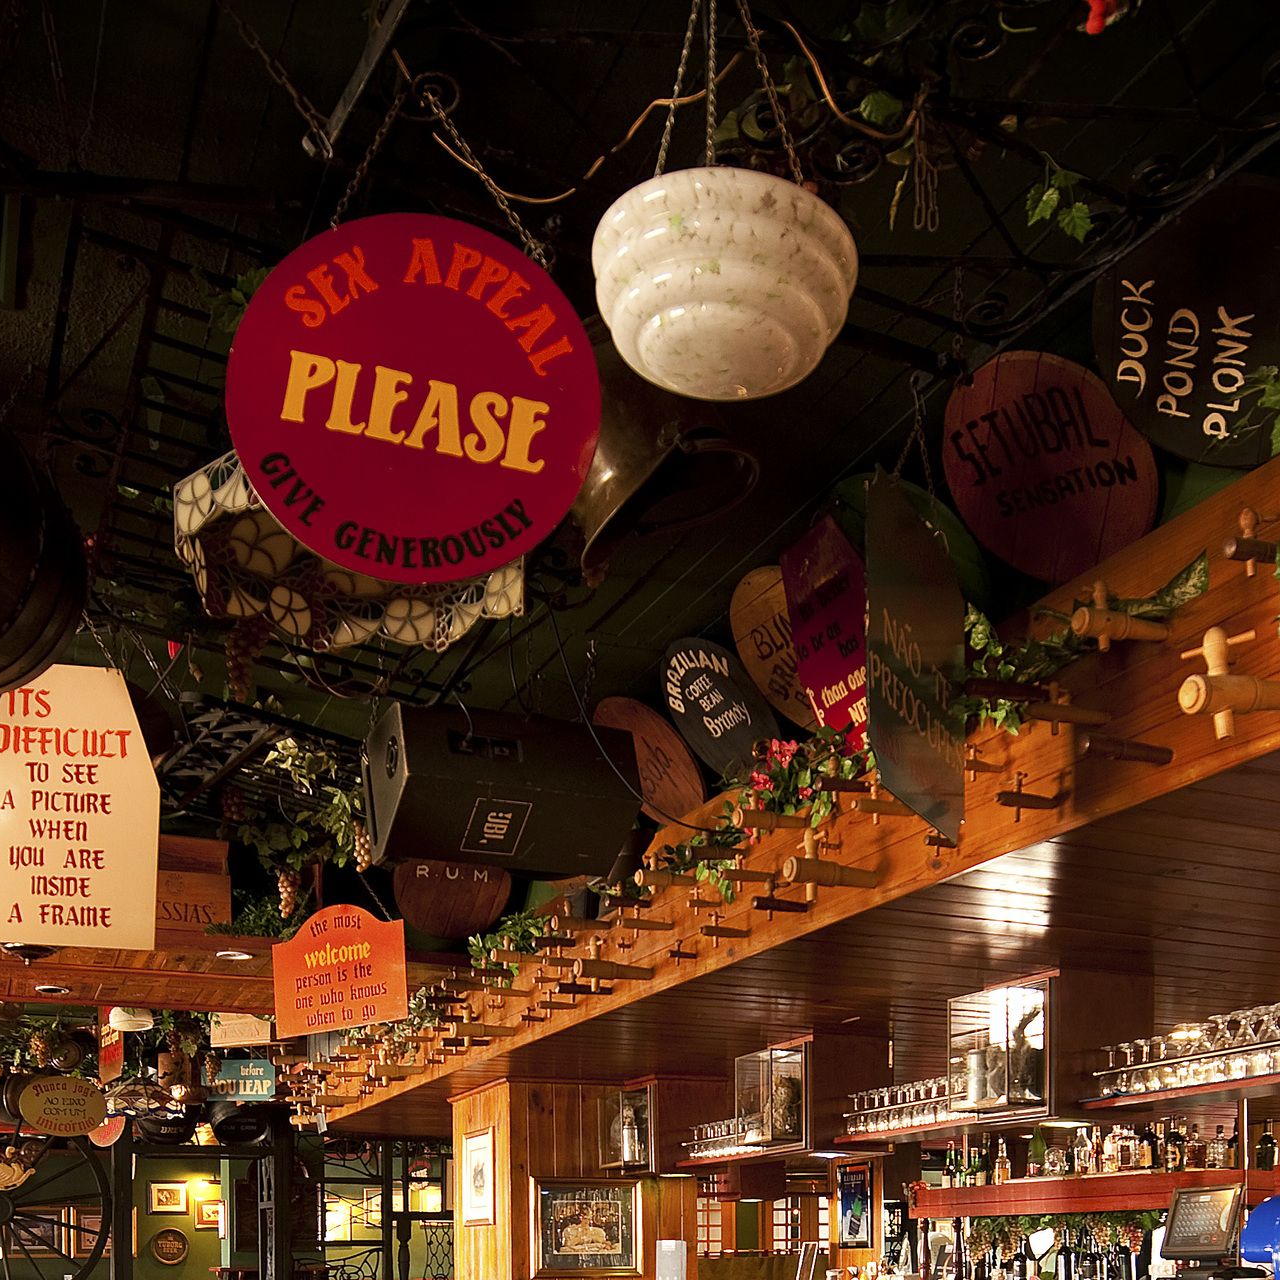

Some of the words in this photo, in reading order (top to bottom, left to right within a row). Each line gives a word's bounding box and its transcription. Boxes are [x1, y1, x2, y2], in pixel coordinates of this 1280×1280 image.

[284, 245, 379, 329] SEX
[403, 238, 573, 376] APPEAL
[1117, 279, 1155, 399] DUCK
[1156, 308, 1200, 418] POND
[1203, 305, 1255, 440] PLONK
[280, 349, 550, 474] PLEASE
[951, 386, 1110, 487] SETUBAL
[996, 456, 1138, 517] SENSATION
[260, 451, 325, 528] GIVE
[334, 498, 533, 569] GENEROUSLY
[751, 613, 793, 661] BLIN
[883, 607, 922, 678] NÃO
[666, 650, 729, 714] BRAZILIAN
[684, 673, 713, 700] COFFEE
[768, 651, 799, 700] DRU
[5, 687, 51, 718] ITS
[699, 689, 724, 712] BEAN
[821, 680, 848, 708] than
[703, 701, 752, 738] Brandy
[25, 761, 49, 783] TO
[61, 763, 99, 785] SEE
[0, 789, 15, 810] A
[30, 790, 112, 815] PICTURE
[28, 818, 88, 842] WHEN
[9, 846, 45, 870] YOU
[63, 849, 105, 870] ARE
[31, 875, 91, 898] INSIDE
[7, 903, 23, 923] A
[39, 903, 112, 928] FRAME
[156, 903, 215, 924] SSIAS
[309, 919, 328, 938] the
[333, 914, 361, 929] most
[304, 942, 371, 969] welcome
[295, 971, 331, 993] person
[337, 967, 347, 982] is
[354, 962, 372, 979] the
[295, 995, 313, 1009] one
[320, 988, 344, 1006] who
[350, 982, 387, 1001] knows
[306, 1009, 336, 1027] when
[342, 1006, 353, 1020] to
[362, 1004, 376, 1021] go
[240, 1063, 265, 1075] before
[32, 1082, 67, 1097] Nunca
[239, 1079, 271, 1095] LEAP
[43, 1097, 59, 1106] AO
